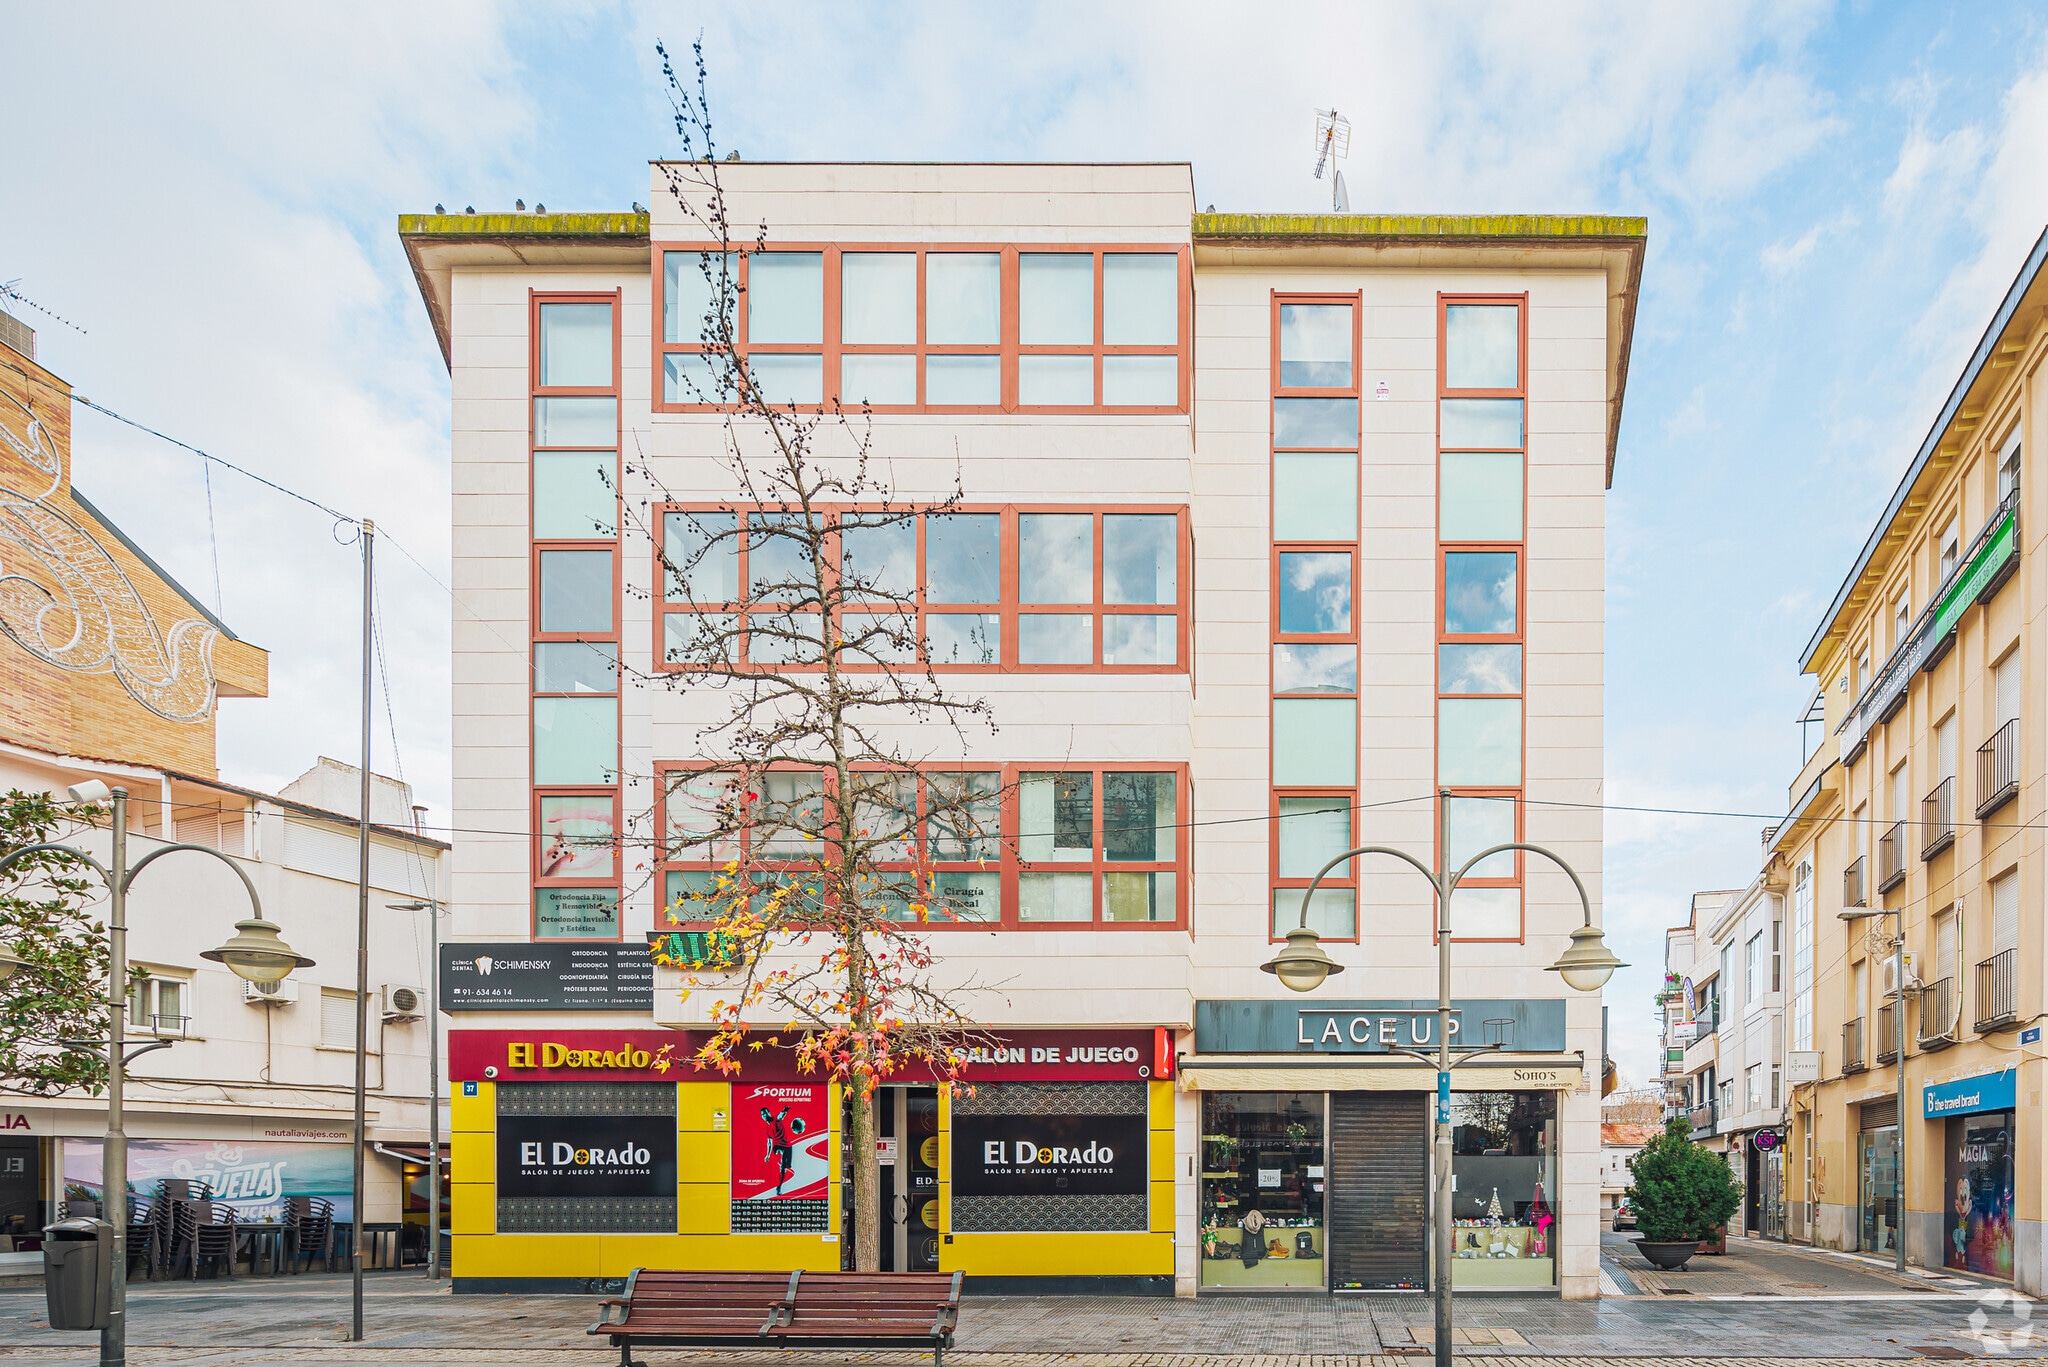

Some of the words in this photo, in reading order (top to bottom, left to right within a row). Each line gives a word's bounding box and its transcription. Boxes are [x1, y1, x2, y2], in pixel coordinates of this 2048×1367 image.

[943, 886, 984, 897] Cirugía
[549, 893, 591, 901] Ortodoncia
[592, 893, 606, 902] Fija
[583, 915, 615, 923] Invisible
[559, 925, 565, 933] y
[566, 924, 596, 932] Estética
[494, 960, 552, 970] SCHIMENSKY
[617, 961, 640, 969] ESTÉTICA
[476, 988, 490, 996] 634
[491, 988, 501, 996] 46
[503, 988, 512, 996] 14
[1031, 1047, 1060, 1063] DE
[1065, 1046, 1139, 1064] JUEGO
[466, 1084, 475, 1093] 37
[745, 1085, 812, 1100] SPORTIUM
[1934, 1098, 1945, 1111] the
[1945, 1094, 1961, 1110] travel
[1961, 1091, 1980, 1108] brand
[264, 1128, 348, 1140] nautaliaviajes.com
[1757, 1135, 1777, 1145] KSP
[1959, 1145, 1988, 1163] MAGIA
